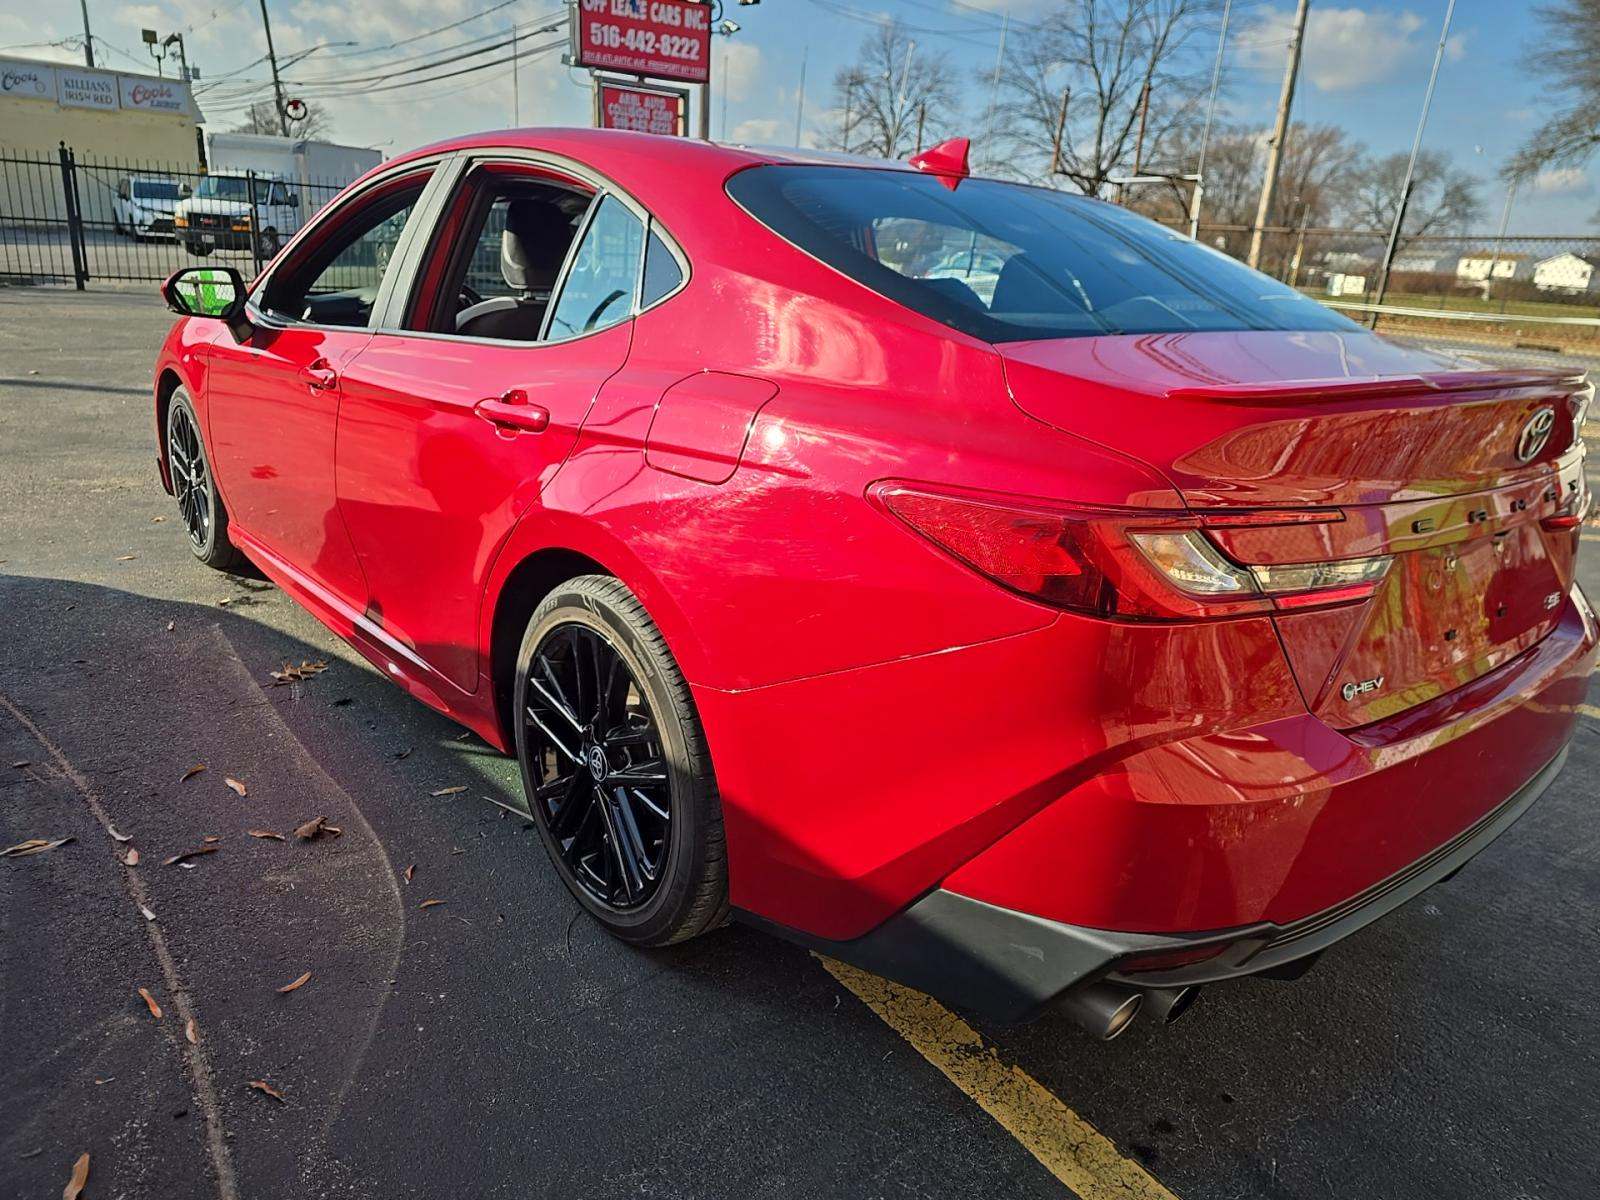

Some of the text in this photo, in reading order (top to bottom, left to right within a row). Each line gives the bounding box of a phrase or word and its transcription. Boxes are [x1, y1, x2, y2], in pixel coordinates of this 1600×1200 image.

[650, 2, 682, 27] CARS
[590, 21, 700, 60] 516-442-8222
[2, 71, 38, 91] Coors
[64, 78, 112, 92] KILLIAN'S
[65, 90, 113, 105] IRISH RED
[131, 85, 174, 105] Coors
